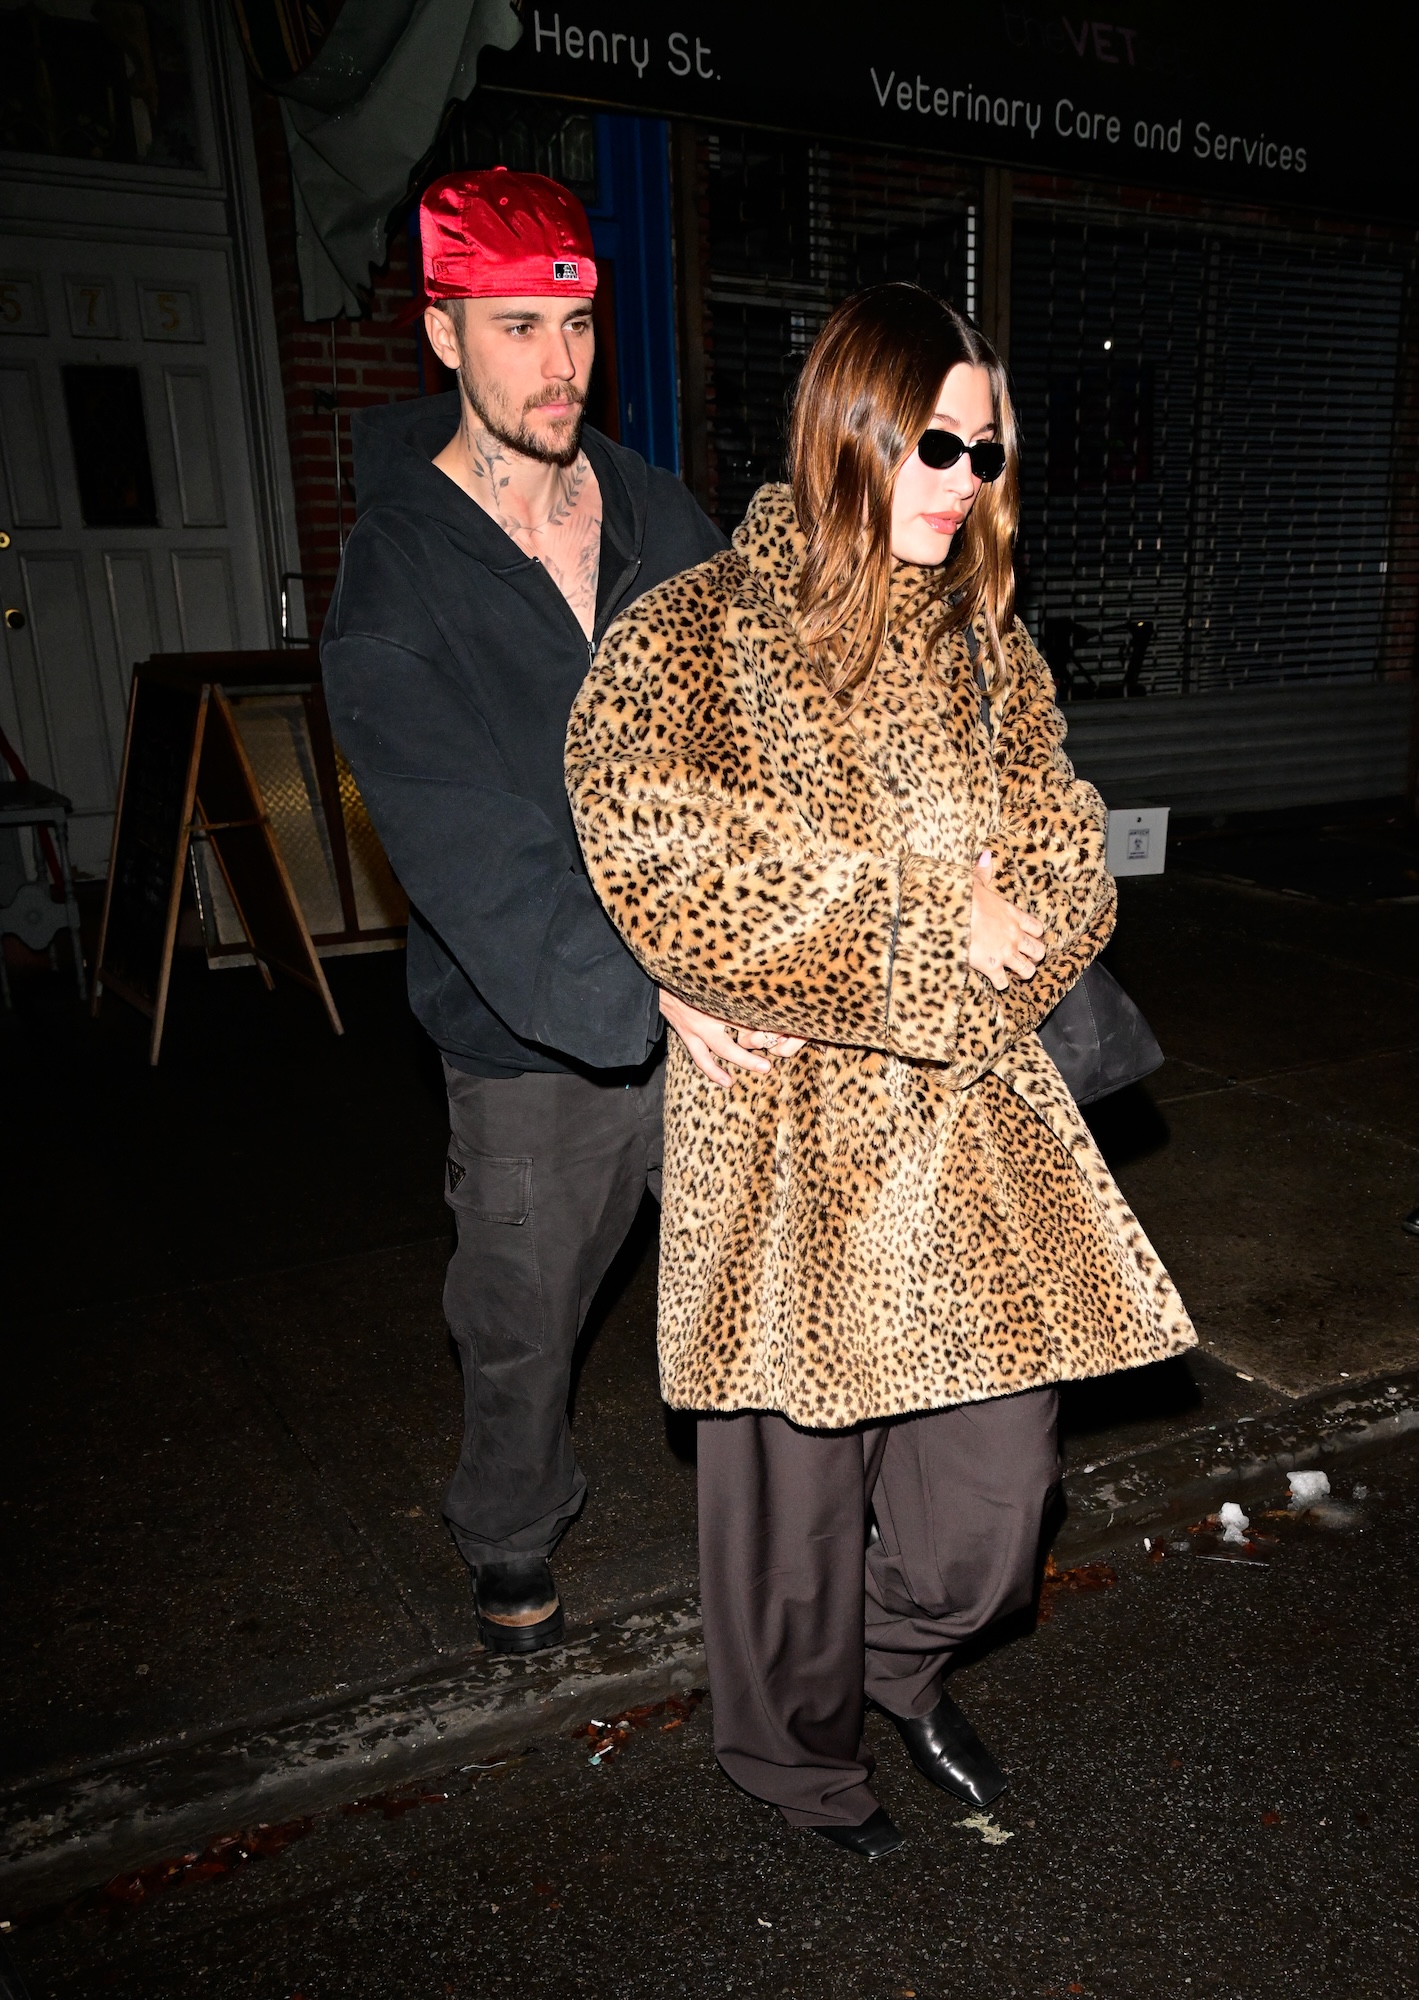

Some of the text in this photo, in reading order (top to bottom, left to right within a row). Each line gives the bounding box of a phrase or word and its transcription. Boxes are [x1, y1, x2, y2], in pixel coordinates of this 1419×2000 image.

[534, 10, 721, 81] Henry St.
[870, 67, 1308, 173] Veterinary Care and Services
